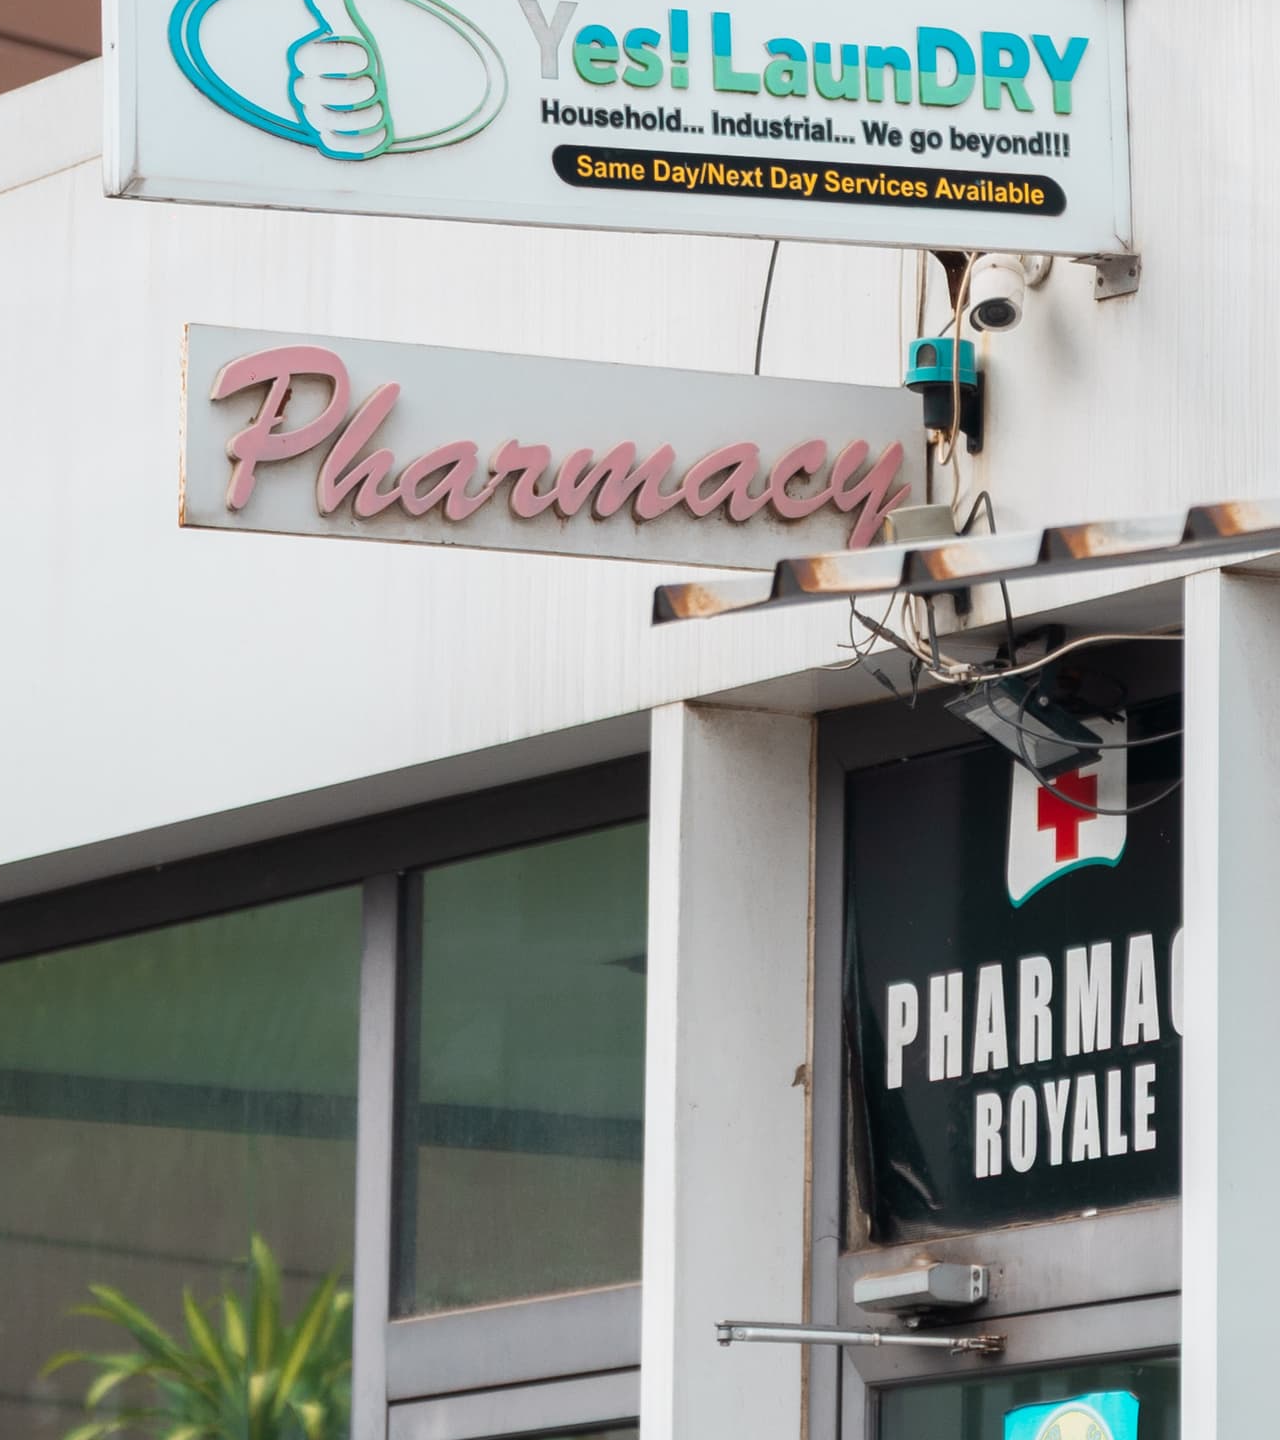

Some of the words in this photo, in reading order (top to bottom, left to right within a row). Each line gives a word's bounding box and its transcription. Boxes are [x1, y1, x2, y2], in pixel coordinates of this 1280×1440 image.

[710, 10, 1090, 116] LaunDRY
[541, 98, 705, 136] Household...
[712, 110, 856, 145] Industrial...
[861, 120, 903, 148] We
[910, 130, 944, 158] go
[950, 126, 1071, 160] beyond!!!
[576, 155, 646, 182] Same
[653, 158, 764, 189] Day/Next
[770, 167, 819, 196] Day
[824, 170, 929, 199] Services
[934, 177, 1045, 206] Available
[209, 345, 912, 551] Pharmacy
[975, 1063, 1158, 1179] ROYALE
